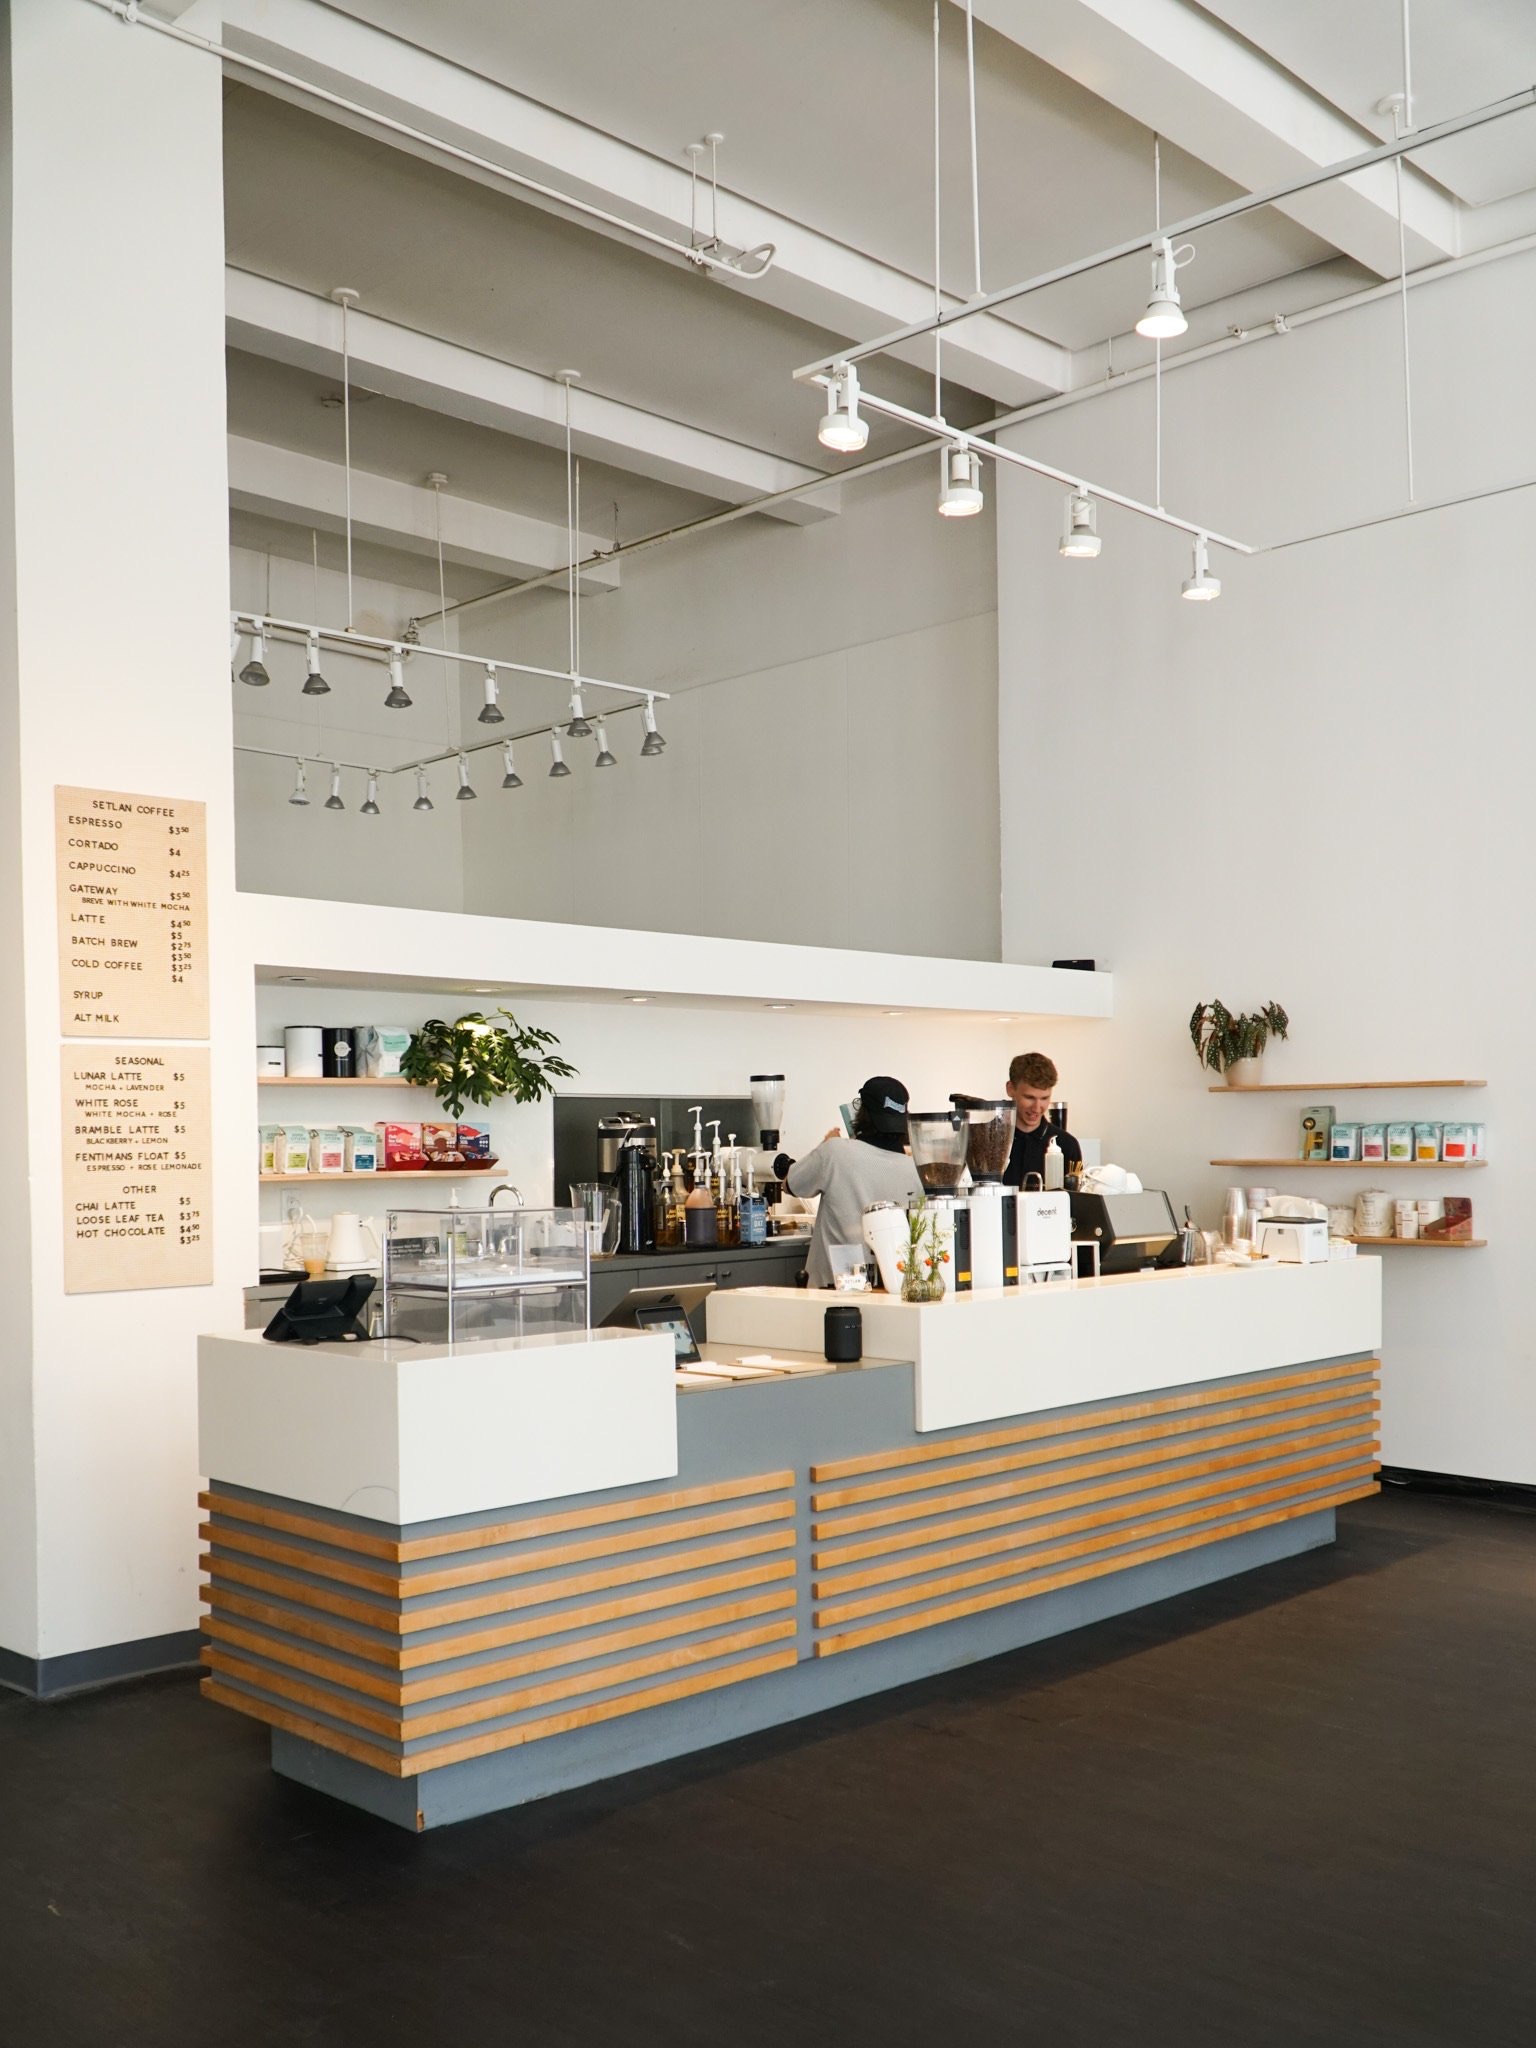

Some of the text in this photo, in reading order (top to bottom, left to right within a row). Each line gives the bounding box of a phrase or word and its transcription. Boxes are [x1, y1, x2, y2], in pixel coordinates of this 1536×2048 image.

[93, 801, 175, 817] SETLAN COFFEE
[69, 816, 122, 829] ESPRESSO
[68, 838, 118, 850] CORTADO
[169, 848, 180, 856] $4
[69, 861, 136, 875] CAPPUCCINO
[69, 884, 118, 895] GATEWAY
[82, 897, 104, 905] BREVE
[71, 914, 105, 924] LATTE
[171, 932, 182, 940] $5
[72, 936, 138, 948] BATCH BREW
[72, 959, 142, 970] COLD COFFEE
[172, 975, 183, 983] $4
[73, 991, 103, 999] SYRUP
[74, 1014, 119, 1023] ALT MILK
[115, 1057, 164, 1066] SEASONAL
[74, 1072, 142, 1081] LUNAR LATTE
[173, 1073, 185, 1081] $5
[75, 1099, 138, 1107] WHITE ROSE
[174, 1101, 185, 1110] $5
[75, 1126, 159, 1134] BRAMBLE LATTE
[174, 1125, 185, 1134] $5
[75, 1152, 169, 1161] FENTIMANS FLOAT
[175, 1152, 186, 1160] $5
[123, 1185, 156, 1194] OTHER
[179, 1197, 190, 1205] $5
[76, 1202, 136, 1211] CHAI LATTE
[1037, 1207, 1057, 1216] decent
[77, 1214, 164, 1225] LOOSE LEAF TEA
[77, 1227, 165, 1239] HOT CHOCOLATE
